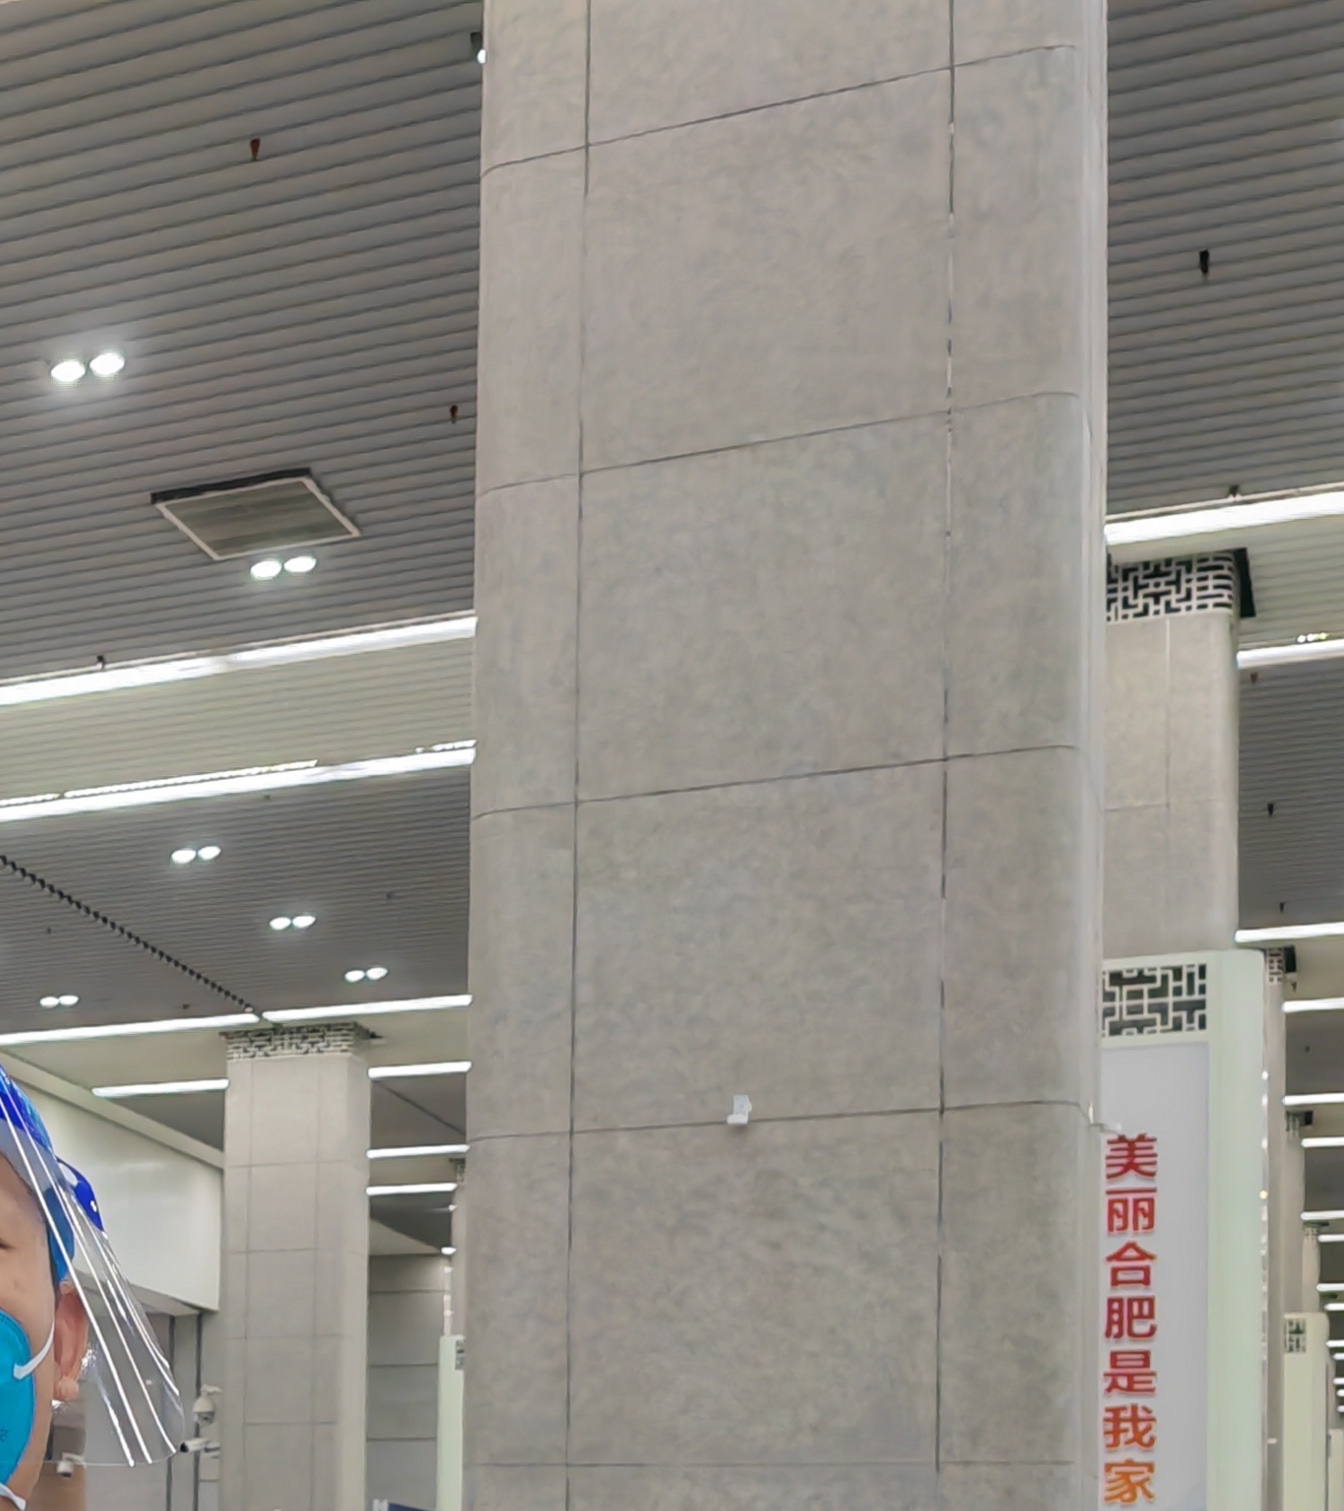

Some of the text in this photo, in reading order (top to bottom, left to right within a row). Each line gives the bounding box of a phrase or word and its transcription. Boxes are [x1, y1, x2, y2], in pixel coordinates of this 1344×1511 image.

[1102, 1132, 1160, 1508] 美丽合肥是我家
